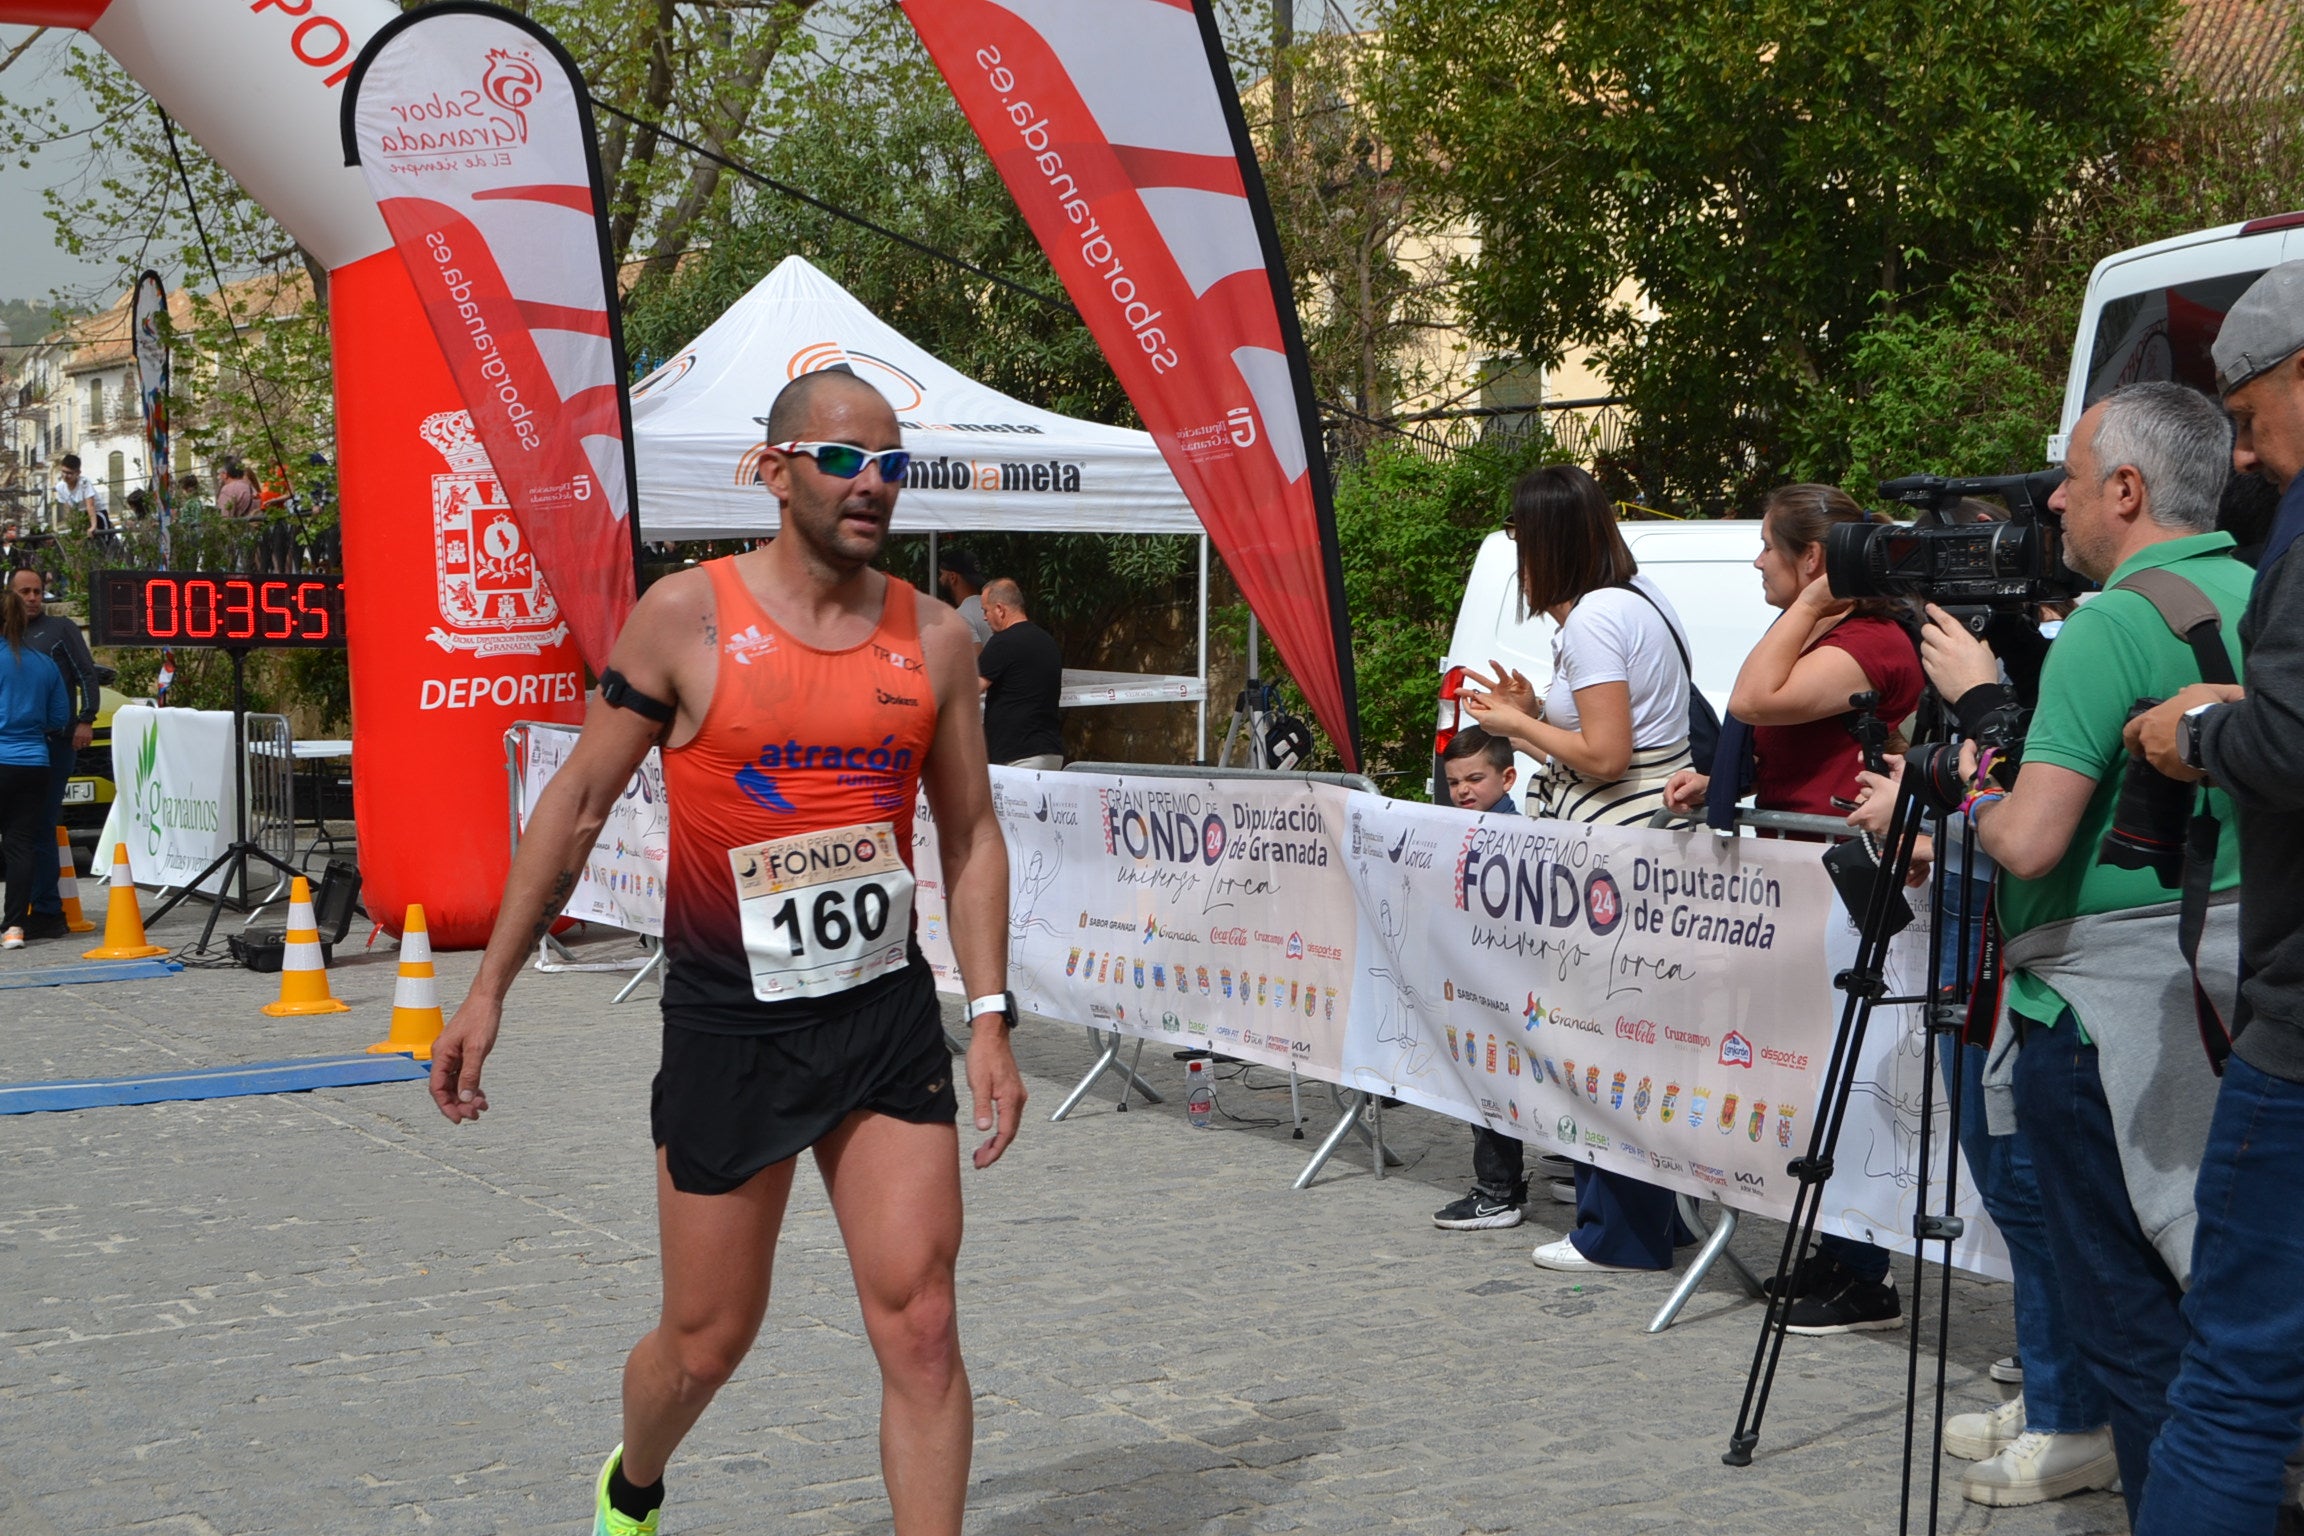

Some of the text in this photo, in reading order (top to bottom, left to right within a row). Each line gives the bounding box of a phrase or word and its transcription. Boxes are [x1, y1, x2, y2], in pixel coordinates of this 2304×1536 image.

[483, 641, 532, 652] GRANADA
[872, 643, 924, 675] TRACK
[421, 672, 576, 710] DEPORTES
[759, 734, 912, 771] atracón
[1106, 788, 1218, 815] GRAN PREMIO DE
[1232, 802, 1326, 838] Diputación
[807, 831, 855, 849] PREMIO
[1110, 807, 1227, 866] FONDO
[1207, 829, 1222, 849] 24
[1229, 834, 1327, 867] de Granada
[1470, 828, 1609, 870] GRAN PREMIO DE
[770, 838, 876, 878] FONDO
[1463, 851, 1622, 936] FONDO
[1633, 857, 1781, 908] Diputación
[1592, 889, 1614, 914] 24
[772, 883, 890, 956] 160
[1088, 917, 1136, 932] SABOR GRANADA
[1158, 924, 1200, 943] Granada
[1634, 900, 1776, 950] de Granada
[1254, 930, 1284, 945] Cruzcampo
[1984, 942, 1994, 968] Mark
[1983, 971, 1992, 980] III
[1456, 987, 1510, 1015] SABOR GRANADA
[1548, 1007, 1604, 1036] Granada
[1665, 1026, 1711, 1047] Cruzcampo
